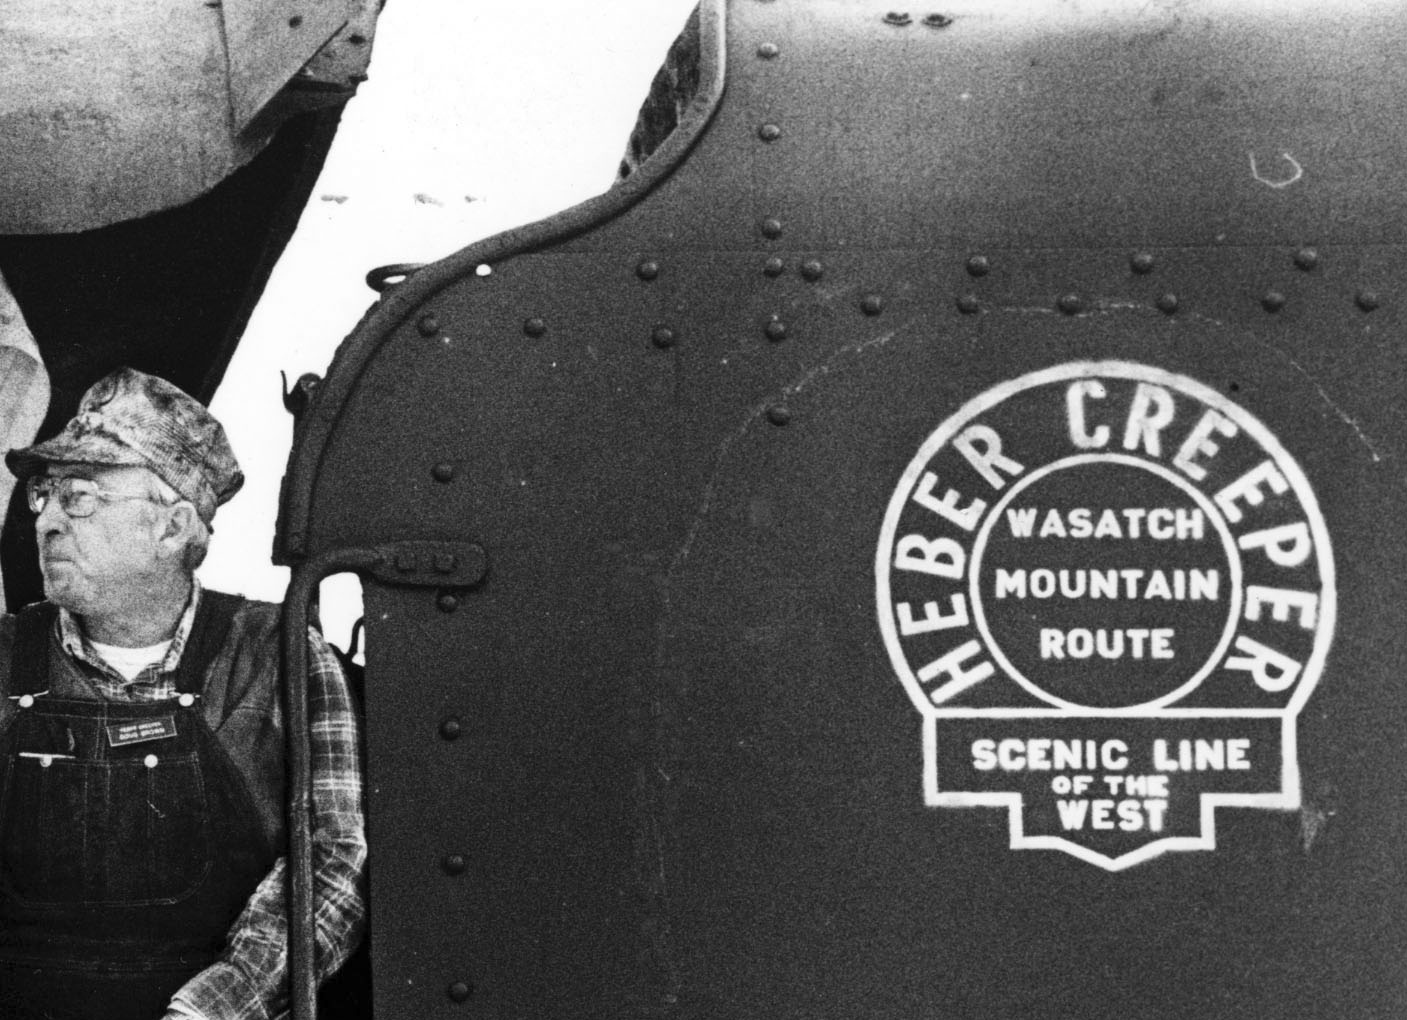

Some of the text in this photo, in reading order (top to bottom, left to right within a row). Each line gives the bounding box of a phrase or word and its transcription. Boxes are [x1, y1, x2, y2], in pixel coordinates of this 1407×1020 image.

[1007, 508, 1204, 540] WASATCH
[895, 380, 1319, 704] HEBER CREEPER
[995, 568, 1220, 601] MOUNTAIN
[1039, 628, 1175, 660] ROUTE
[971, 738, 1251, 772] SCENIC LINE
[1051, 774, 1170, 797] OF THE
[1056, 799, 1169, 832] WEST
